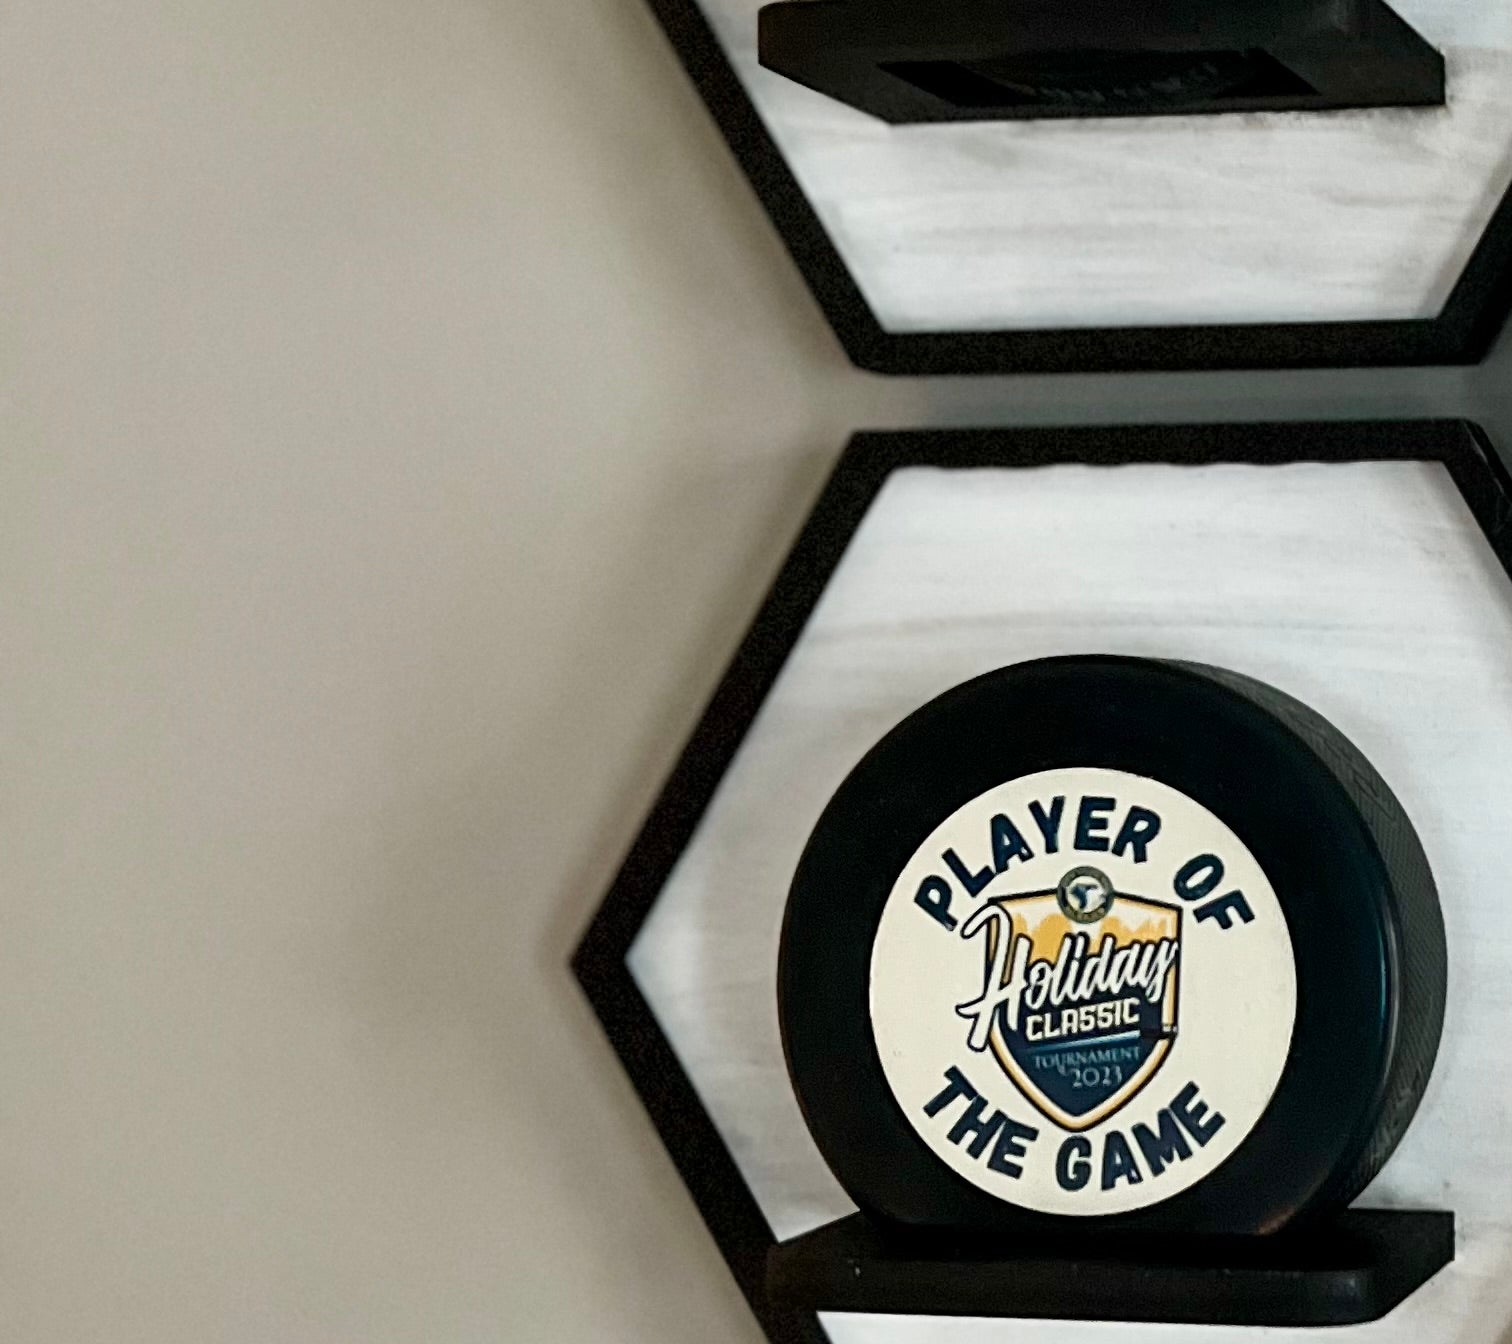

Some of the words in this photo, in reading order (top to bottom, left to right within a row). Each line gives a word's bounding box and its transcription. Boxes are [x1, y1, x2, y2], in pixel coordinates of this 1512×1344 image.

[914, 796, 1161, 931] PLAYER
[1173, 853, 1255, 930] OF
[956, 898, 1178, 1053] Holiday
[1025, 997, 1140, 1042] CLASSIC
[1034, 1046, 1140, 1075] TOURNAMENT
[923, 1066, 1039, 1180] THE
[1055, 1081, 1227, 1192] GAME
